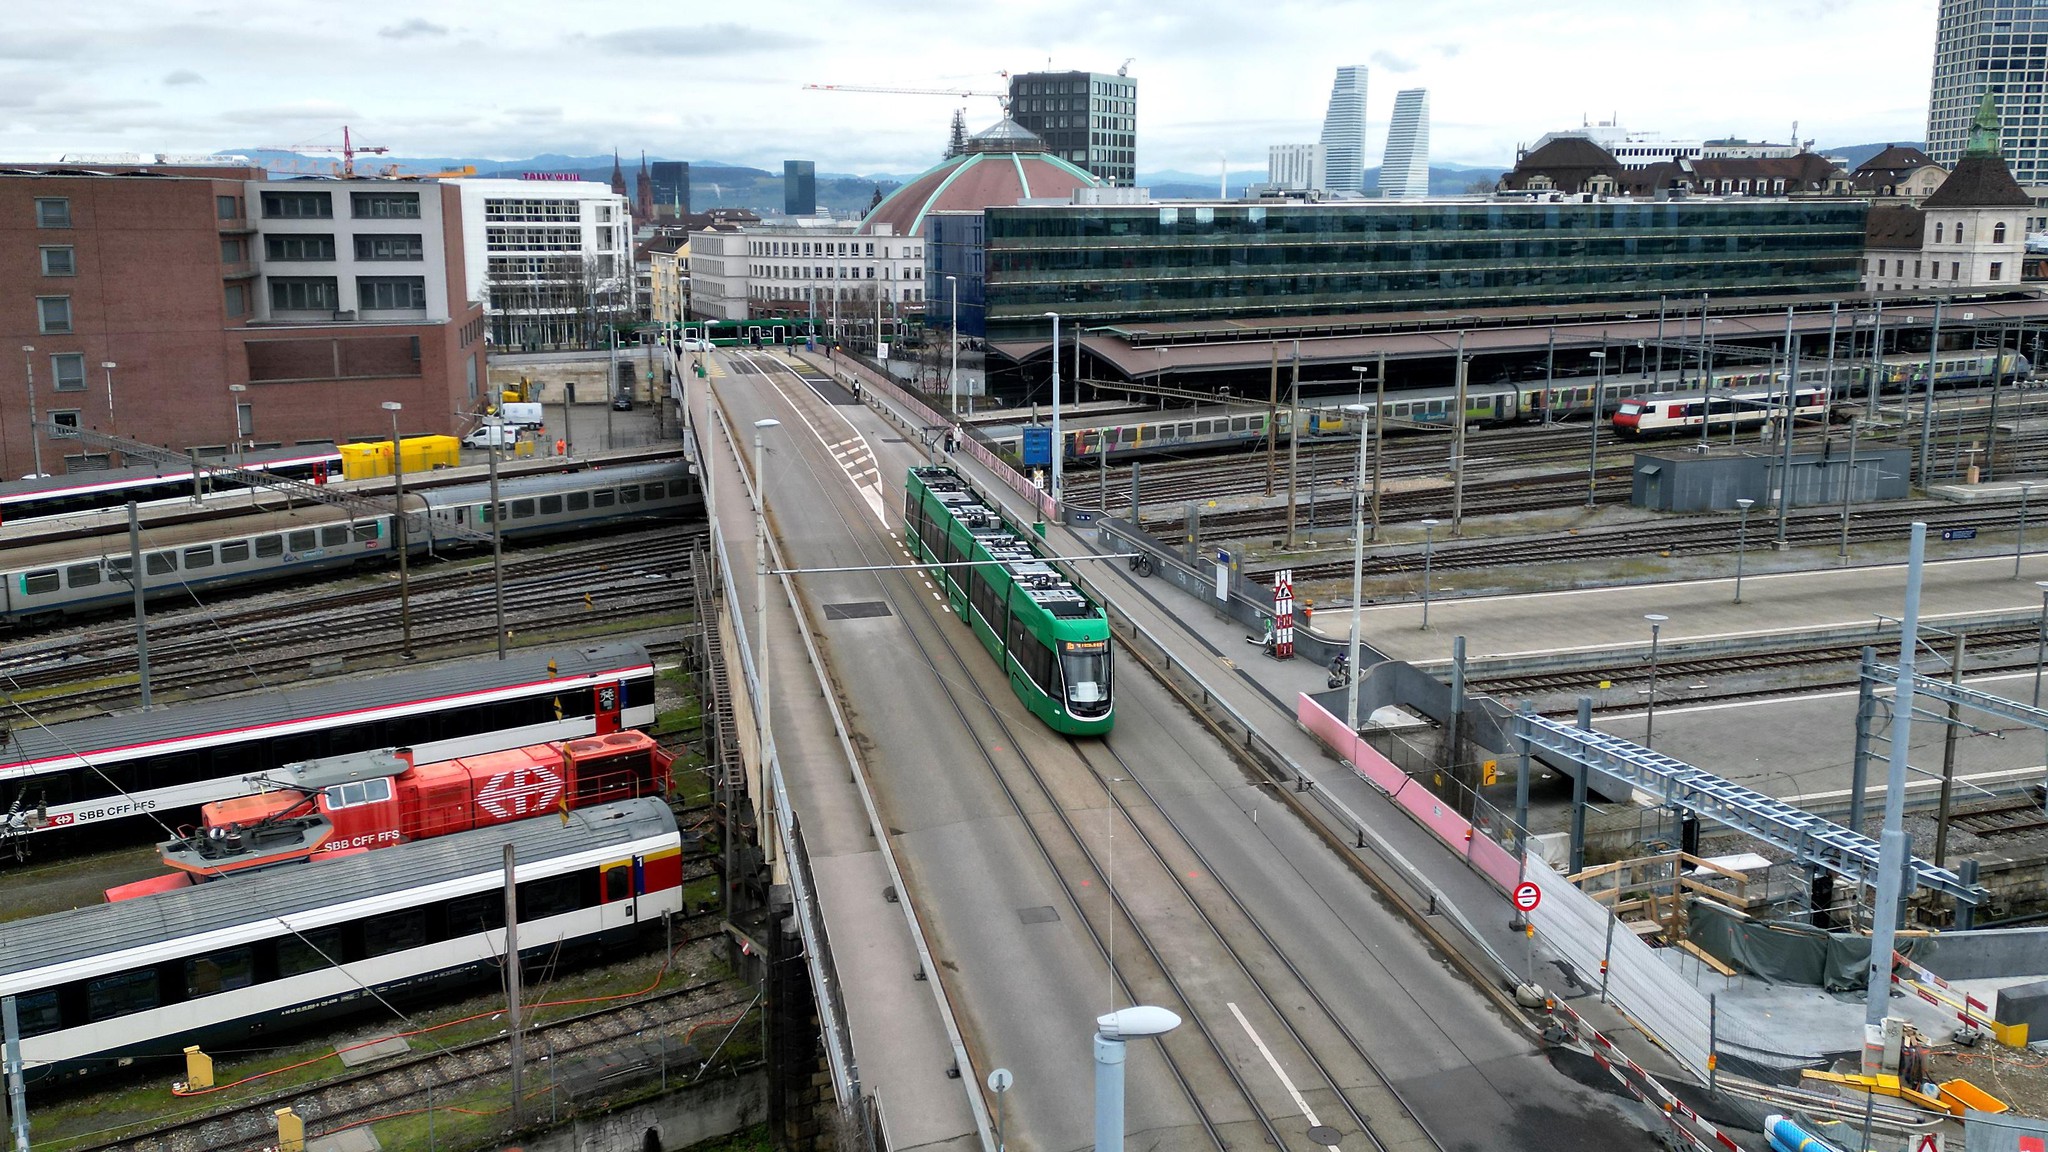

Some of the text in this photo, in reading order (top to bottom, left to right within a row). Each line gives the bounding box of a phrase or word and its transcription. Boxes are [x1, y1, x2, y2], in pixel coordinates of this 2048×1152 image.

[523, 172, 551, 180] TALLY
[1490, 765, 1496, 773] S
[79, 800, 156, 820] SBB CFF FFS
[324, 829, 400, 852] SBB CFF FFS
[637, 856, 643, 867] 1
